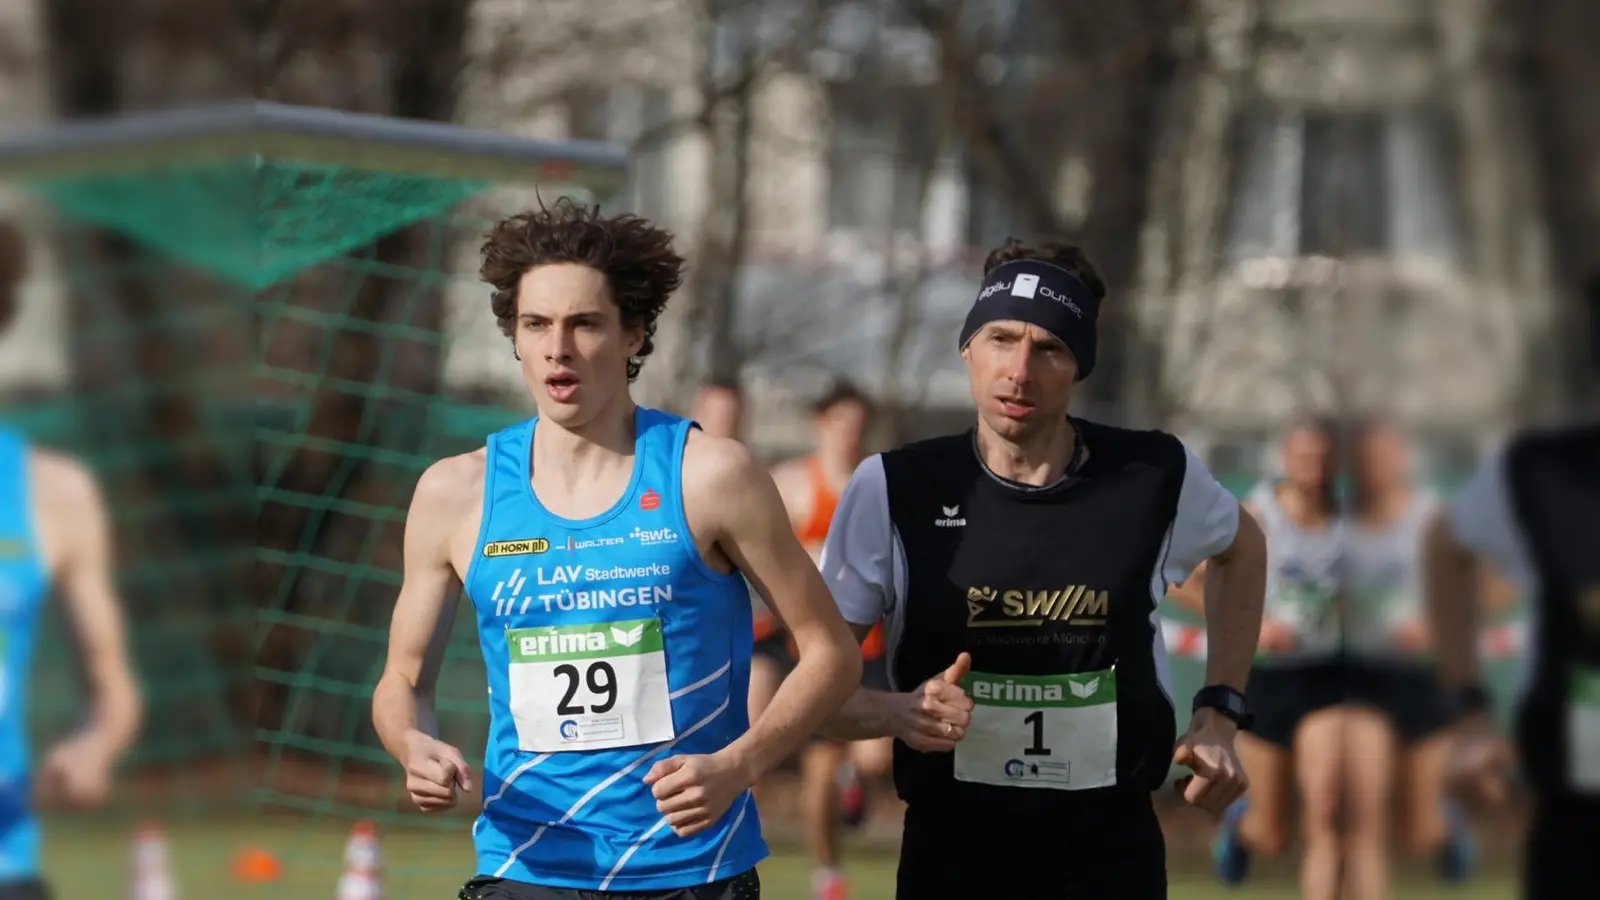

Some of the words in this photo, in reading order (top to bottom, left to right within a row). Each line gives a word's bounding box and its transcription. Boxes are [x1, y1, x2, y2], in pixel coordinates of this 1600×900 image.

[934, 517, 967, 527] erima
[500, 542, 530, 554] HORN
[574, 537, 625, 550] WALTER
[537, 565, 582, 585] LAV
[585, 563, 670, 581] Stadtwerke
[537, 585, 673, 612] TÜBINGEN
[520, 626, 606, 656] erima
[1053, 632, 1106, 645] Münchn
[553, 661, 618, 716] 29
[972, 679, 1063, 701] erima
[1023, 710, 1052, 756] 1
